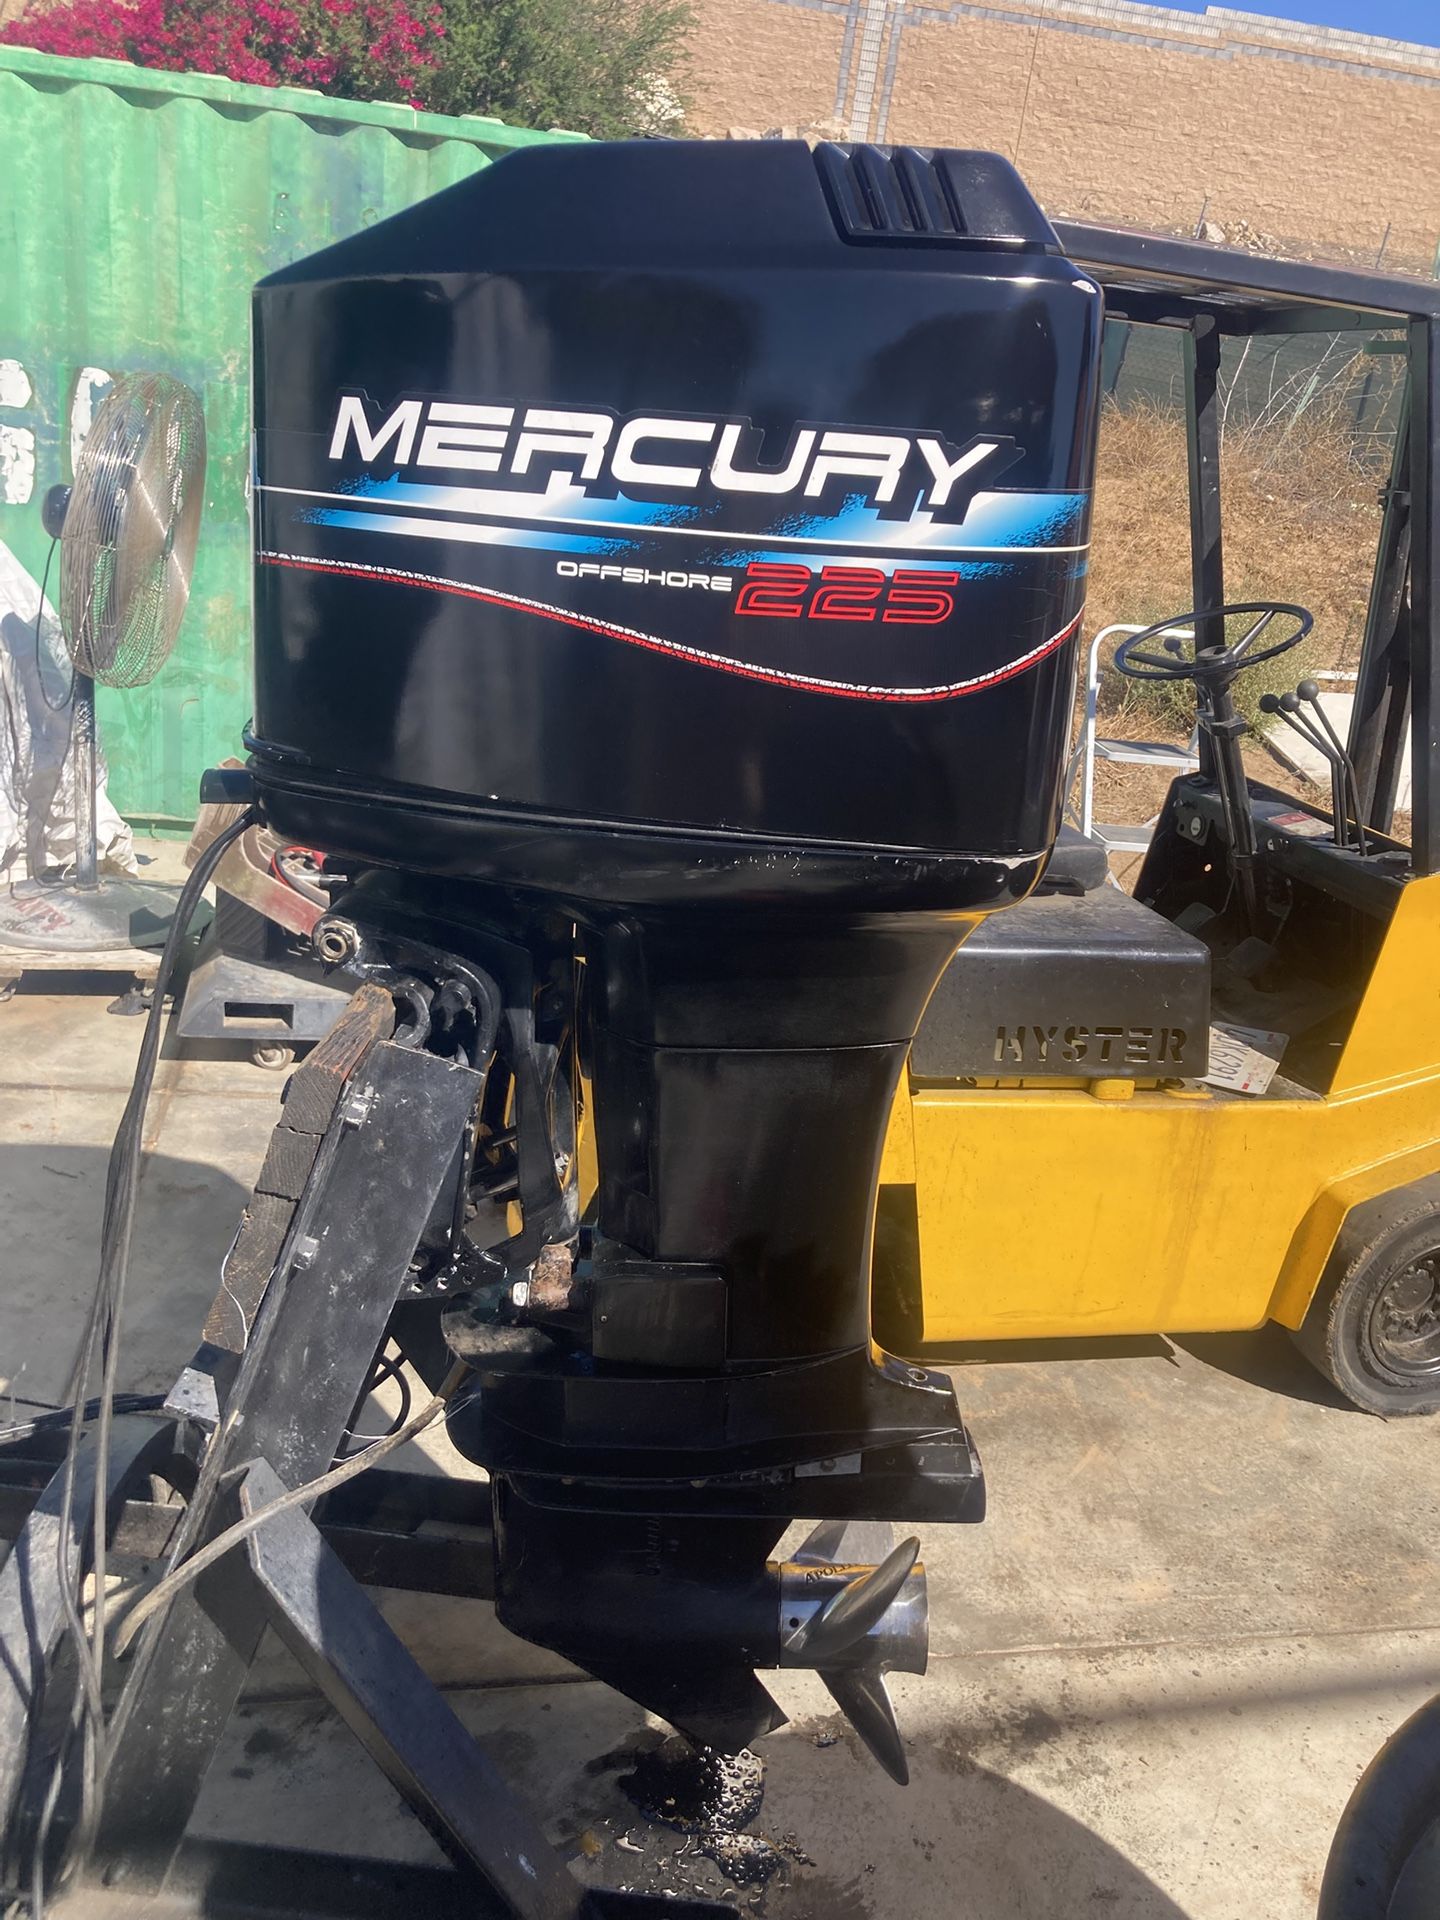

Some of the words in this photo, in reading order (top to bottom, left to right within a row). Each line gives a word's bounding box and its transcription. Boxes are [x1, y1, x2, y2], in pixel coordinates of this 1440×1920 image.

[329, 396, 998, 505] MERCURY
[556, 560, 733, 592] OFFSHORE
[734, 562, 960, 625] 225
[993, 1025, 1188, 1063] HYSTER
